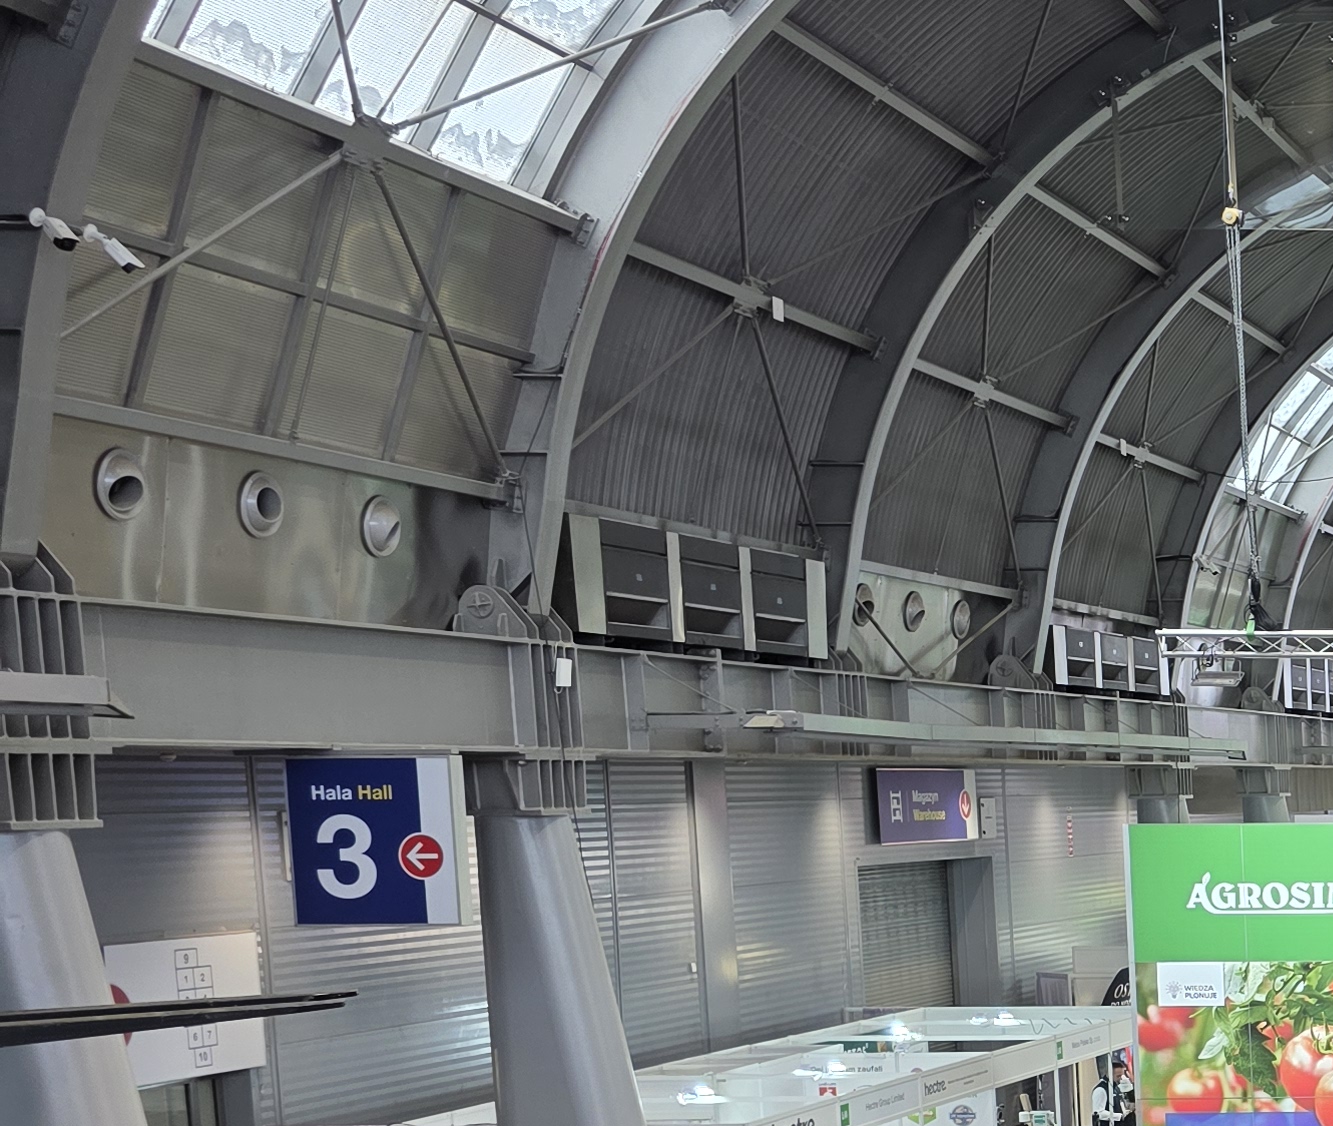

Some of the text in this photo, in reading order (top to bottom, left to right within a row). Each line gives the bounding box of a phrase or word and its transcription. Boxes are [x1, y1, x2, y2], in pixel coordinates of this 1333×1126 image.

[311, 785, 393, 800] Hala Hall
[316, 813, 378, 900] 3
[183, 953, 189, 964] 9
[184, 973, 205, 983] 1 2
[1184, 991, 1218, 999] PLONUJE
[193, 1030, 212, 1041] 6 7
[198, 1051, 208, 1062] 10
[923, 1080, 947, 1096] hectre
